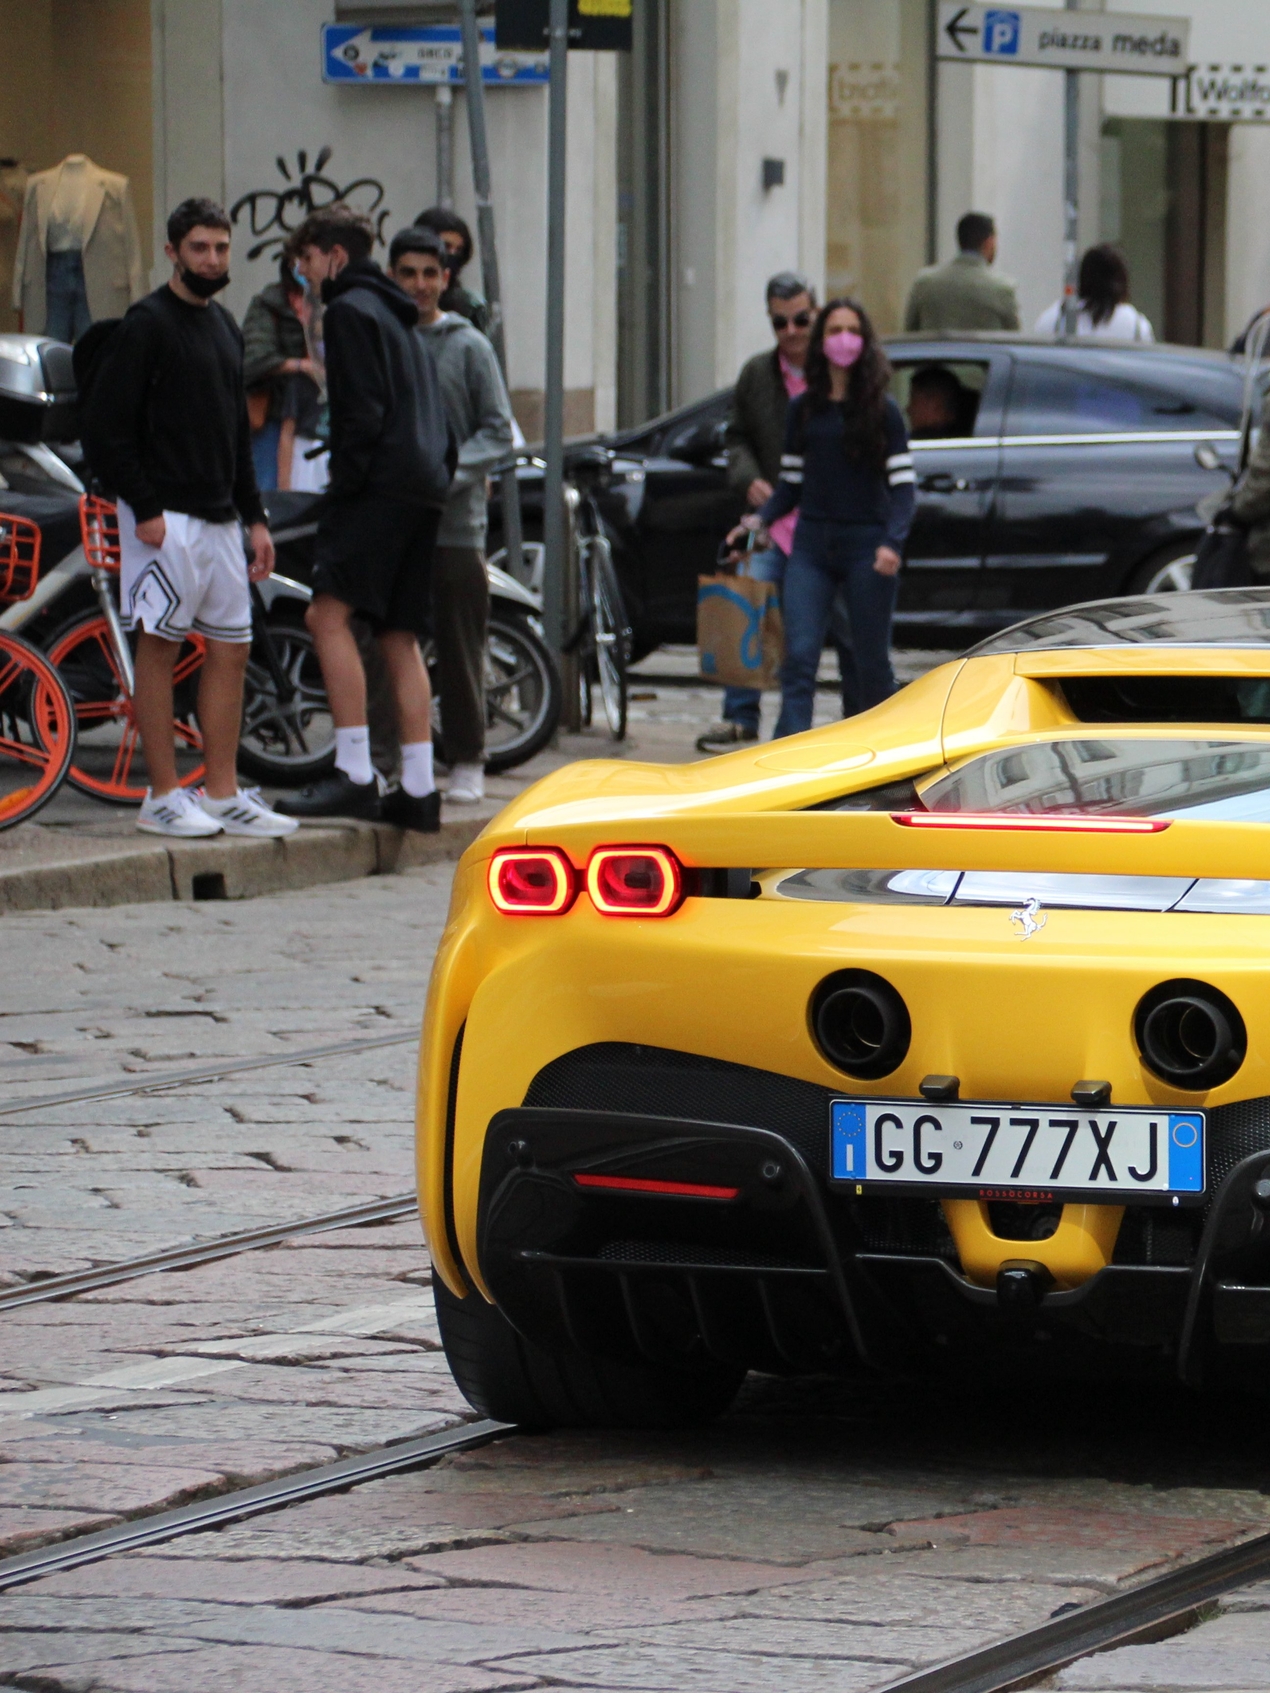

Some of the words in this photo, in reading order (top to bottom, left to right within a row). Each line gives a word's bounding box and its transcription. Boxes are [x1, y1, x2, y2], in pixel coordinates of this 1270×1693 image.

[1038, 28, 1101, 51] piazza
[1112, 32, 1182, 58] meda
[874, 1113, 943, 1174] GG
[970, 1116, 1158, 1182] 777XJ
[980, 1189, 1053, 1199] ROSSOCORSA
